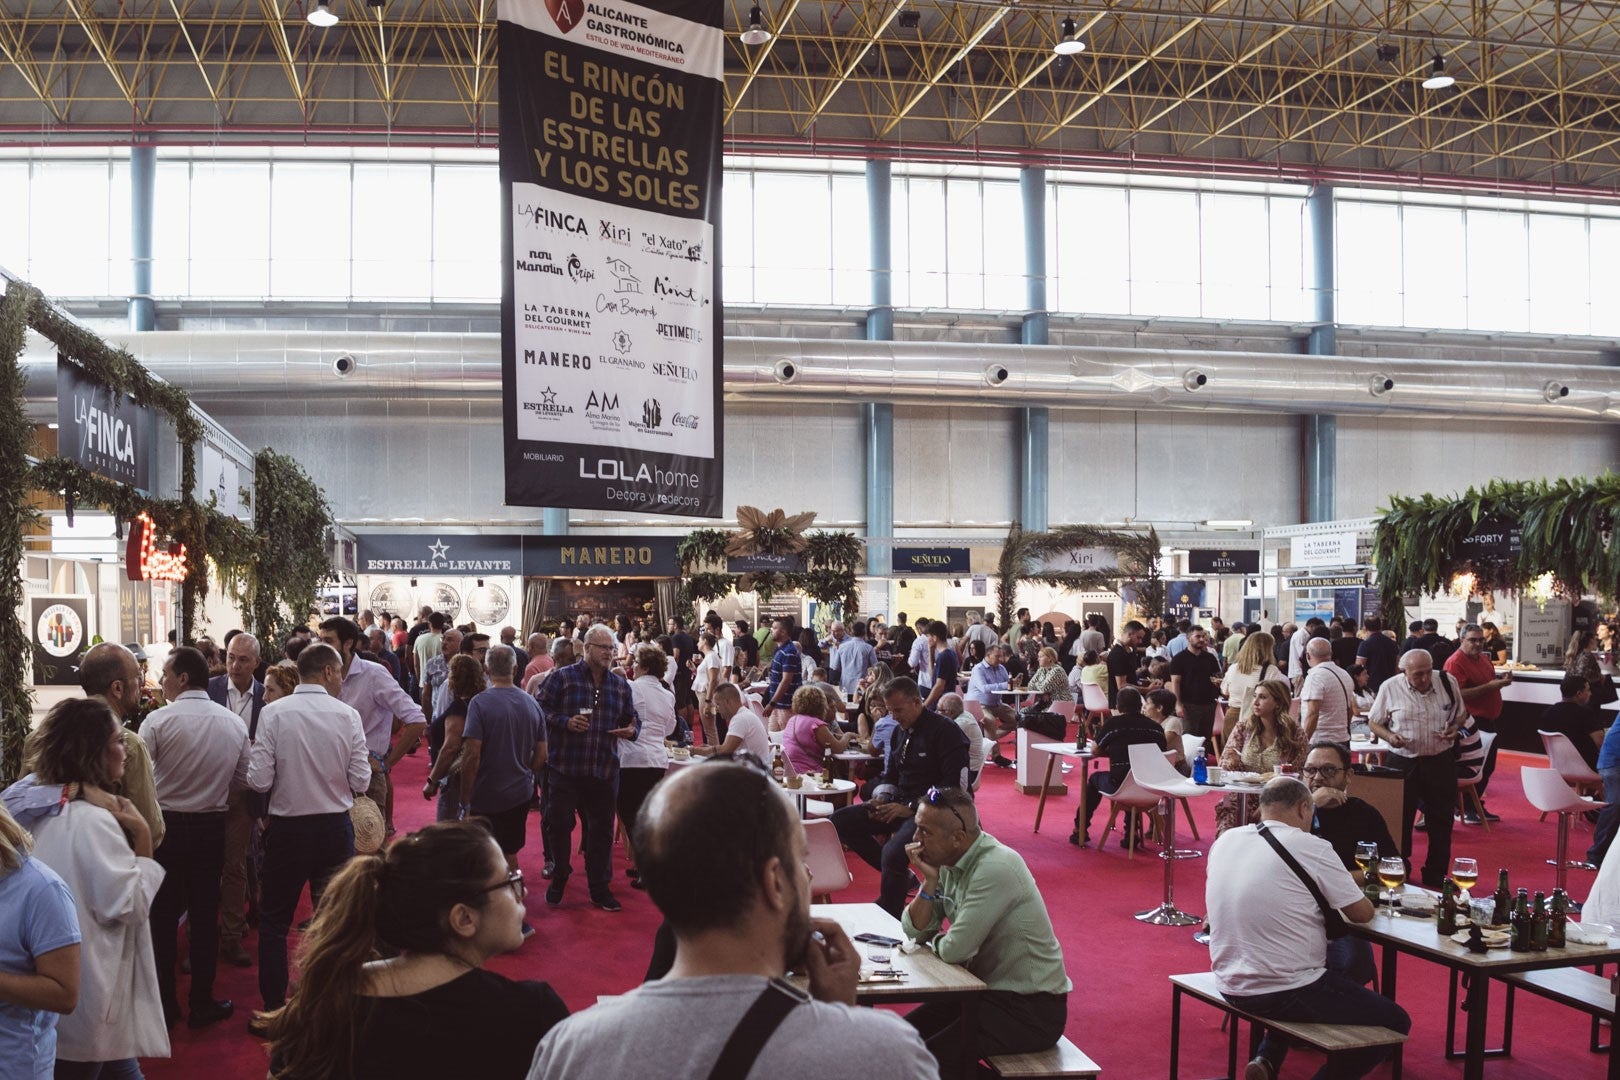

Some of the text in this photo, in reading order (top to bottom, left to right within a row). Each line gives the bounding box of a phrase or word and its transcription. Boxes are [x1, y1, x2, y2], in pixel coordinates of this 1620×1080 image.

[587, 3, 648, 29] ALICANTE
[586, 33, 609, 45] ESTILO
[620, 43, 637, 53] VIDA
[587, 19, 684, 54] GASTRONÓMICA
[544, 50, 685, 111] EL RINCÓN
[570, 91, 661, 138] DE LAS
[543, 118, 689, 176] ESTRELLAS
[534, 149, 700, 210] Y LOS SOLES
[518, 204, 534, 216] LA
[535, 207, 588, 236] FINCA
[600, 219, 631, 242] Xiri
[529, 250, 552, 261] nou
[524, 304, 591, 320] LA TABERNA
[525, 314, 591, 329] DEL GOURMET
[524, 349, 591, 370] MANERO
[599, 355, 608, 364] EL
[652, 361, 698, 382] SEÑUELO
[523, 402, 574, 413] ESTRELLA
[585, 390, 619, 412] AM
[585, 411, 601, 419] Alma
[74, 394, 135, 466] LA FINCA
[523, 453, 565, 462] MOBILIARIO
[606, 487, 700, 507] Decora y redecora
[1313, 540, 1341, 548] TABERNA
[1475, 534, 1504, 544] FORTY
[367, 560, 439, 570] ESTRELLA
[449, 560, 511, 570] LEVANTE
[560, 547, 652, 565] MANERO
[911, 553, 951, 565] SEÑUELO
[1069, 552, 1093, 564] Xiri
[1334, 577, 1364, 585] GOURMET
